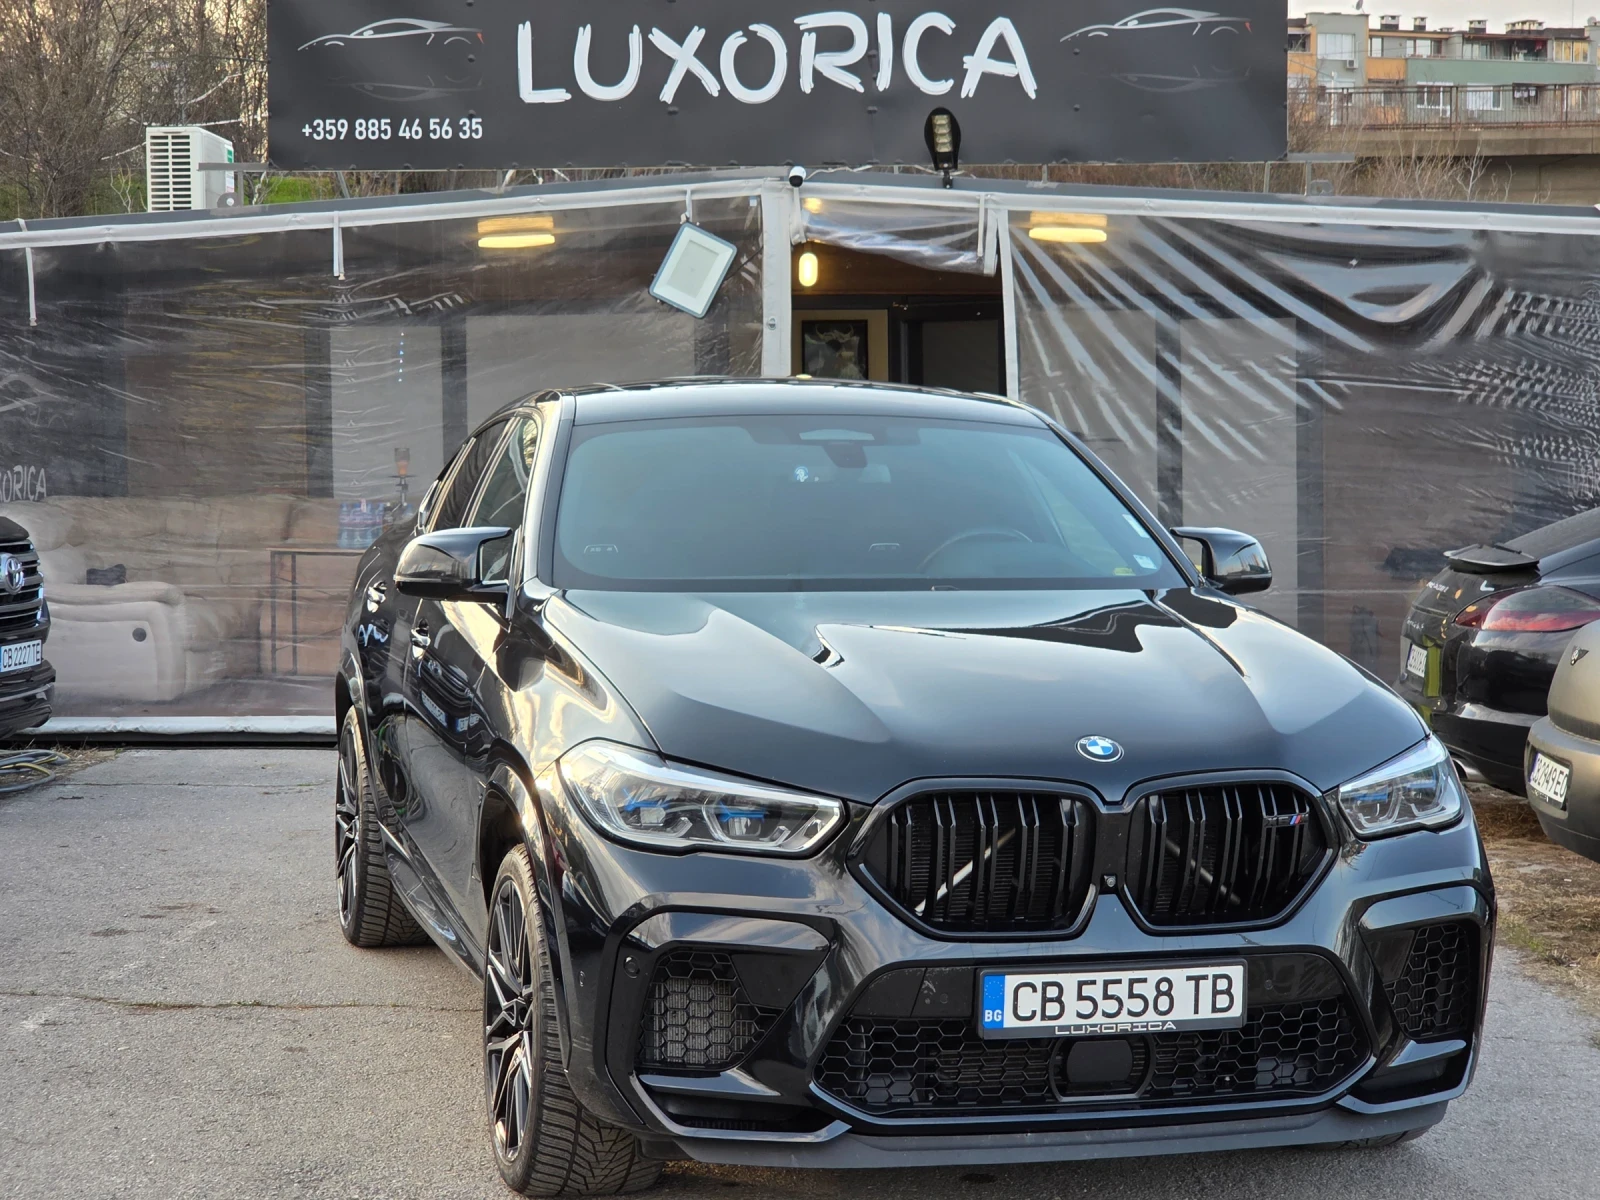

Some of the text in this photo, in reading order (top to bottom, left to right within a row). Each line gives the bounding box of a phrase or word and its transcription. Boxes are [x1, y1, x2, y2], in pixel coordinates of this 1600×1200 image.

[517, 11, 1036, 104] LUXORICA
[301, 118, 482, 140] +359 885 46 56 35
[0, 465, 47, 502] ORICA
[3, 648, 12, 668] CB
[1012, 973, 1234, 1022] CB 5558 TB
[984, 1010, 1002, 1022] BG
[1055, 1021, 1177, 1035] LUXORICA
